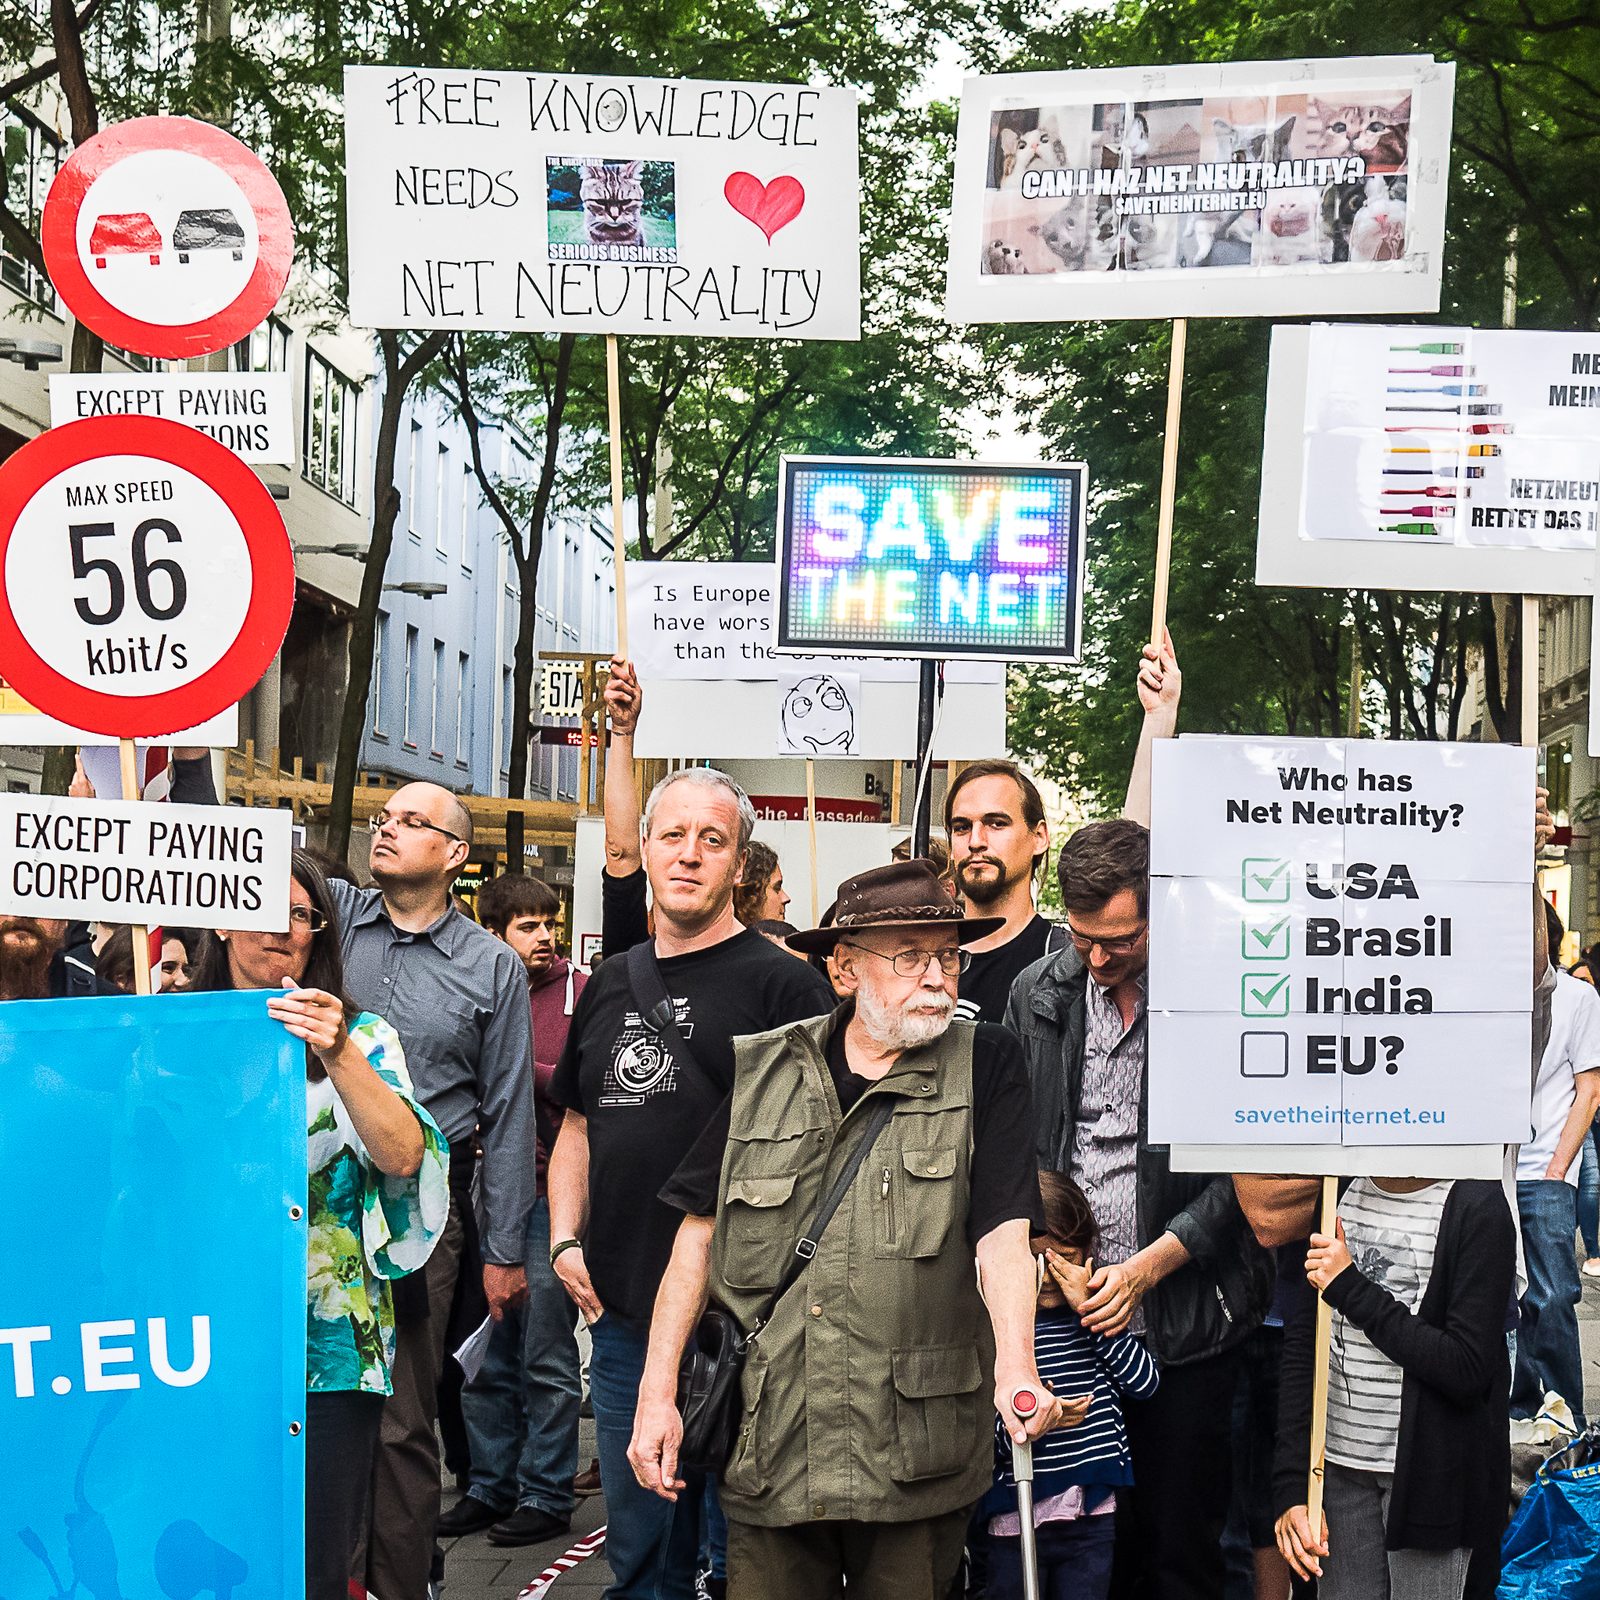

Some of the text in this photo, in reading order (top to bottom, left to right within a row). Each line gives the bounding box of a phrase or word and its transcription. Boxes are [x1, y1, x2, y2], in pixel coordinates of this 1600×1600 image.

[387, 71, 820, 146] FREE KNOWLEDGE
[395, 167, 519, 208] NEEDS
[1022, 170, 1077, 198] CAN
[1099, 167, 1142, 195] HAZ
[1146, 164, 1192, 193] NET
[1196, 156, 1366, 191] NEUTRALITY?
[1115, 191, 1267, 216] SAVETHEINTERNET.EU
[549, 243, 677, 263] SERIOUS BUSINESS
[402, 260, 821, 330] NET NEUTRALITY
[179, 389, 267, 415] PAYING
[66, 480, 173, 507] MAX SPEED
[812, 486, 1051, 563] SAVE
[1471, 507, 1540, 529] RETTET
[1544, 510, 1582, 532] DAS
[69, 518, 187, 625] 56
[653, 585, 770, 606] Is Europe
[798, 567, 1061, 626] THE NET
[653, 613, 770, 631] have wors
[86, 634, 188, 676] kbit/s
[674, 641, 777, 660] than the
[1277, 766, 1413, 792] Who has
[1226, 798, 1465, 833] Net Neutrality?
[15, 812, 263, 863] EXCEPT PAYING
[12, 860, 262, 910] CORPORATIONS
[1304, 862, 1419, 900] USA
[1304, 914, 1453, 958] Brasil
[1304, 974, 1433, 1015] India
[1305, 1035, 1405, 1076] EU?
[1234, 1105, 1446, 1126] savetheinternet.eu
[1571, 1465, 1600, 1478] IKE
